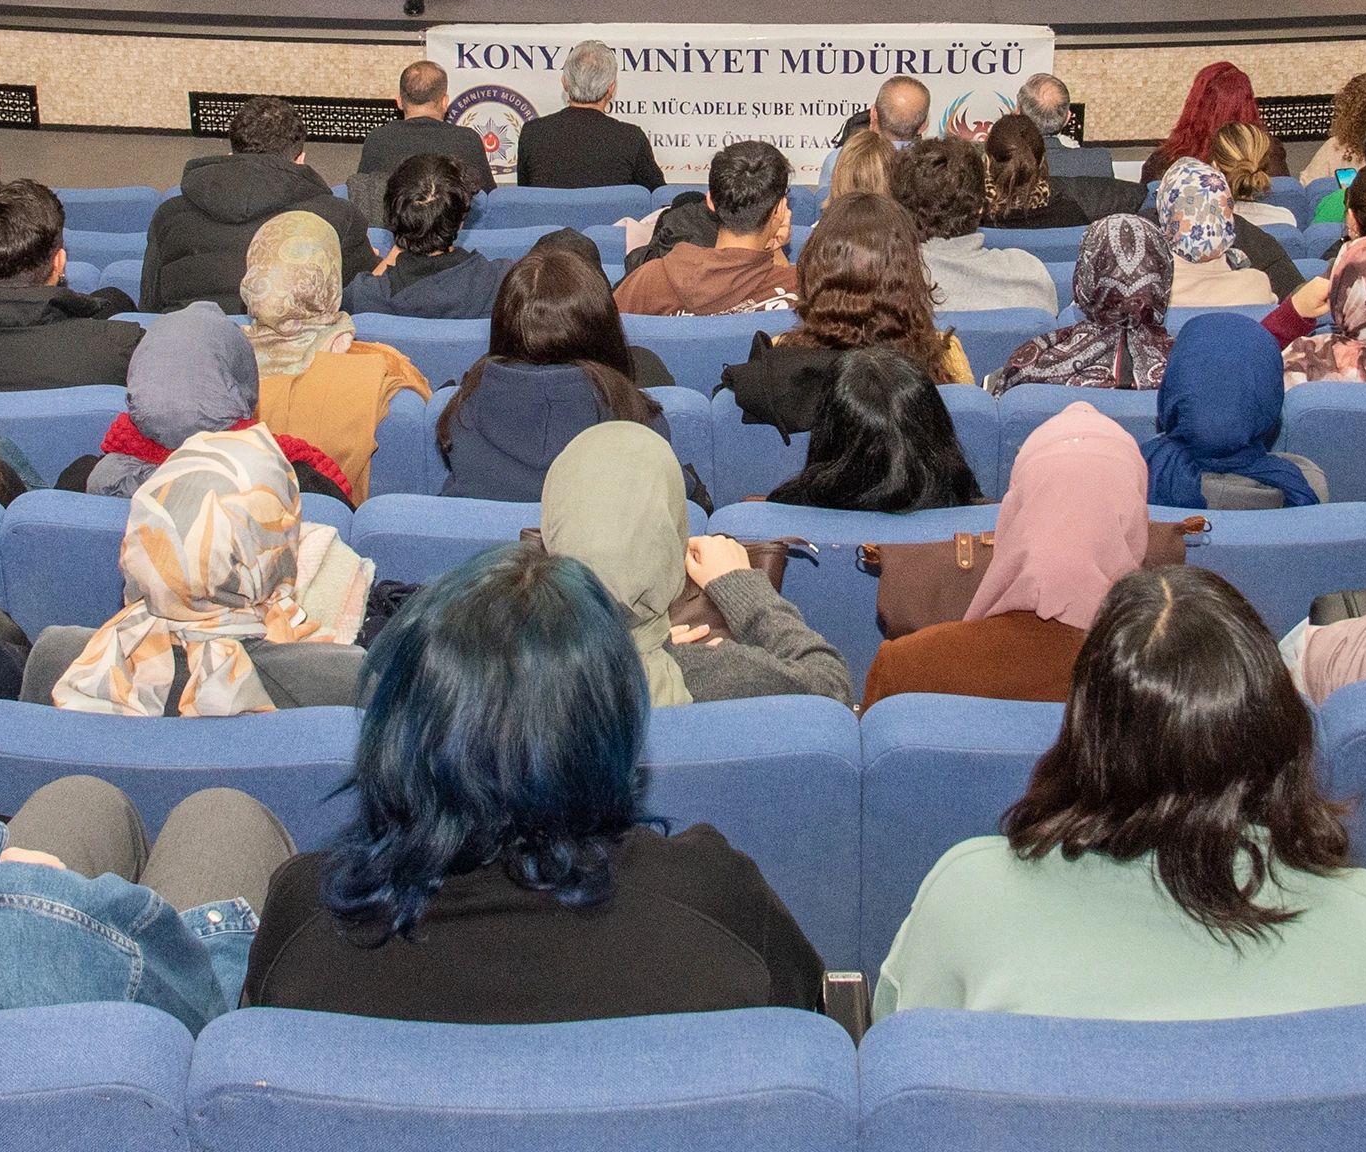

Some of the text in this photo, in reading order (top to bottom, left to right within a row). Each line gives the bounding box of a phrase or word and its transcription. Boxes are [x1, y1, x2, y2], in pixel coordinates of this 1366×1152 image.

[455, 41, 1025, 75] KONY MNİYET MÜDÜRLÜĞÜ
[457, 90, 499, 109] EMNİYET
[652, 98, 747, 116] MÜCADELE
[751, 102, 795, 119] ŞUBE
[695, 133, 718, 148] VE
